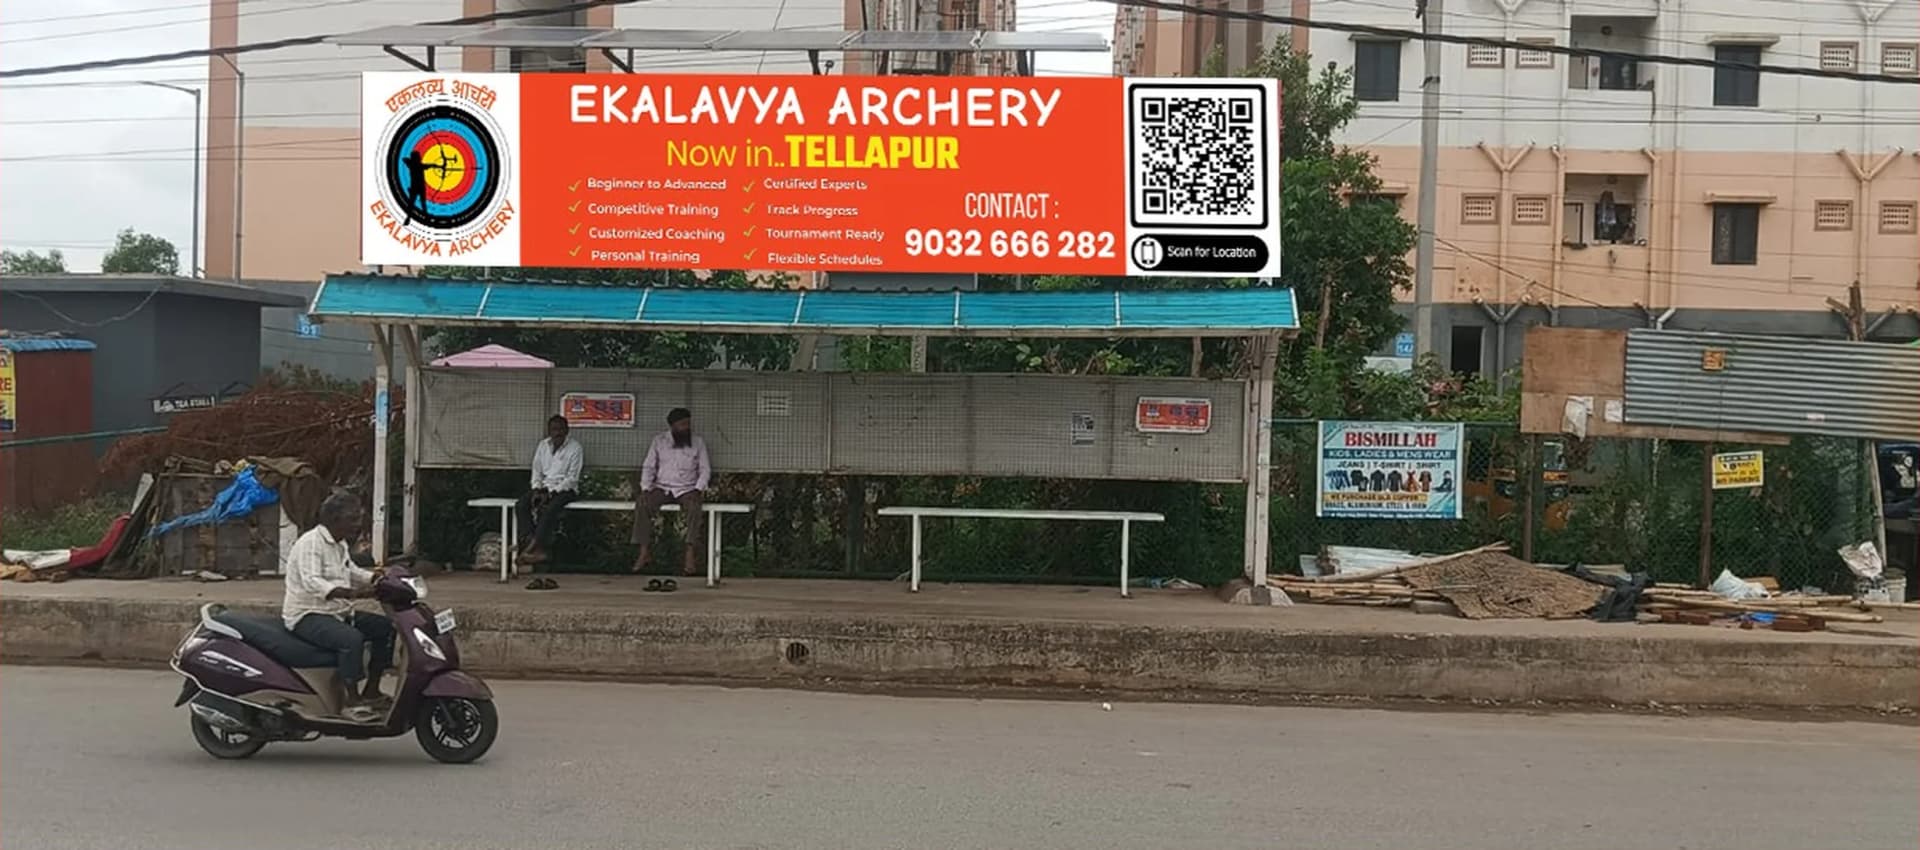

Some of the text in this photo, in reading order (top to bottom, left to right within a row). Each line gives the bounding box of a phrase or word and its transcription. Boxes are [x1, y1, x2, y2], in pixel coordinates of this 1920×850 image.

[570, 84, 1062, 127] EKALAVYA ARCHERY
[667, 140, 737, 167] Now
[587, 177, 727, 191] Beginner to Advanced
[763, 177, 868, 192] Certified Experts
[587, 202, 719, 219] Competitive Training
[767, 204, 859, 219] Track Progress
[964, 192, 1050, 219] CONTACT
[370, 199, 515, 257] EKALAVYA ARCHERY
[588, 227, 725, 243] Customized Coaching
[766, 227, 885, 243] Tournament Ready
[904, 228, 1116, 259] 9032 666 282
[1167, 245, 1257, 258] Scan for Location
[591, 249, 701, 264] Personal Training
[767, 252, 883, 266] Flexible Schedules
[1344, 431, 1437, 447] BISMILLAH
[1354, 450, 1387, 458] LADIES
[1424, 451, 1451, 459] WEAR
[1416, 461, 1441, 469] SHIRT
